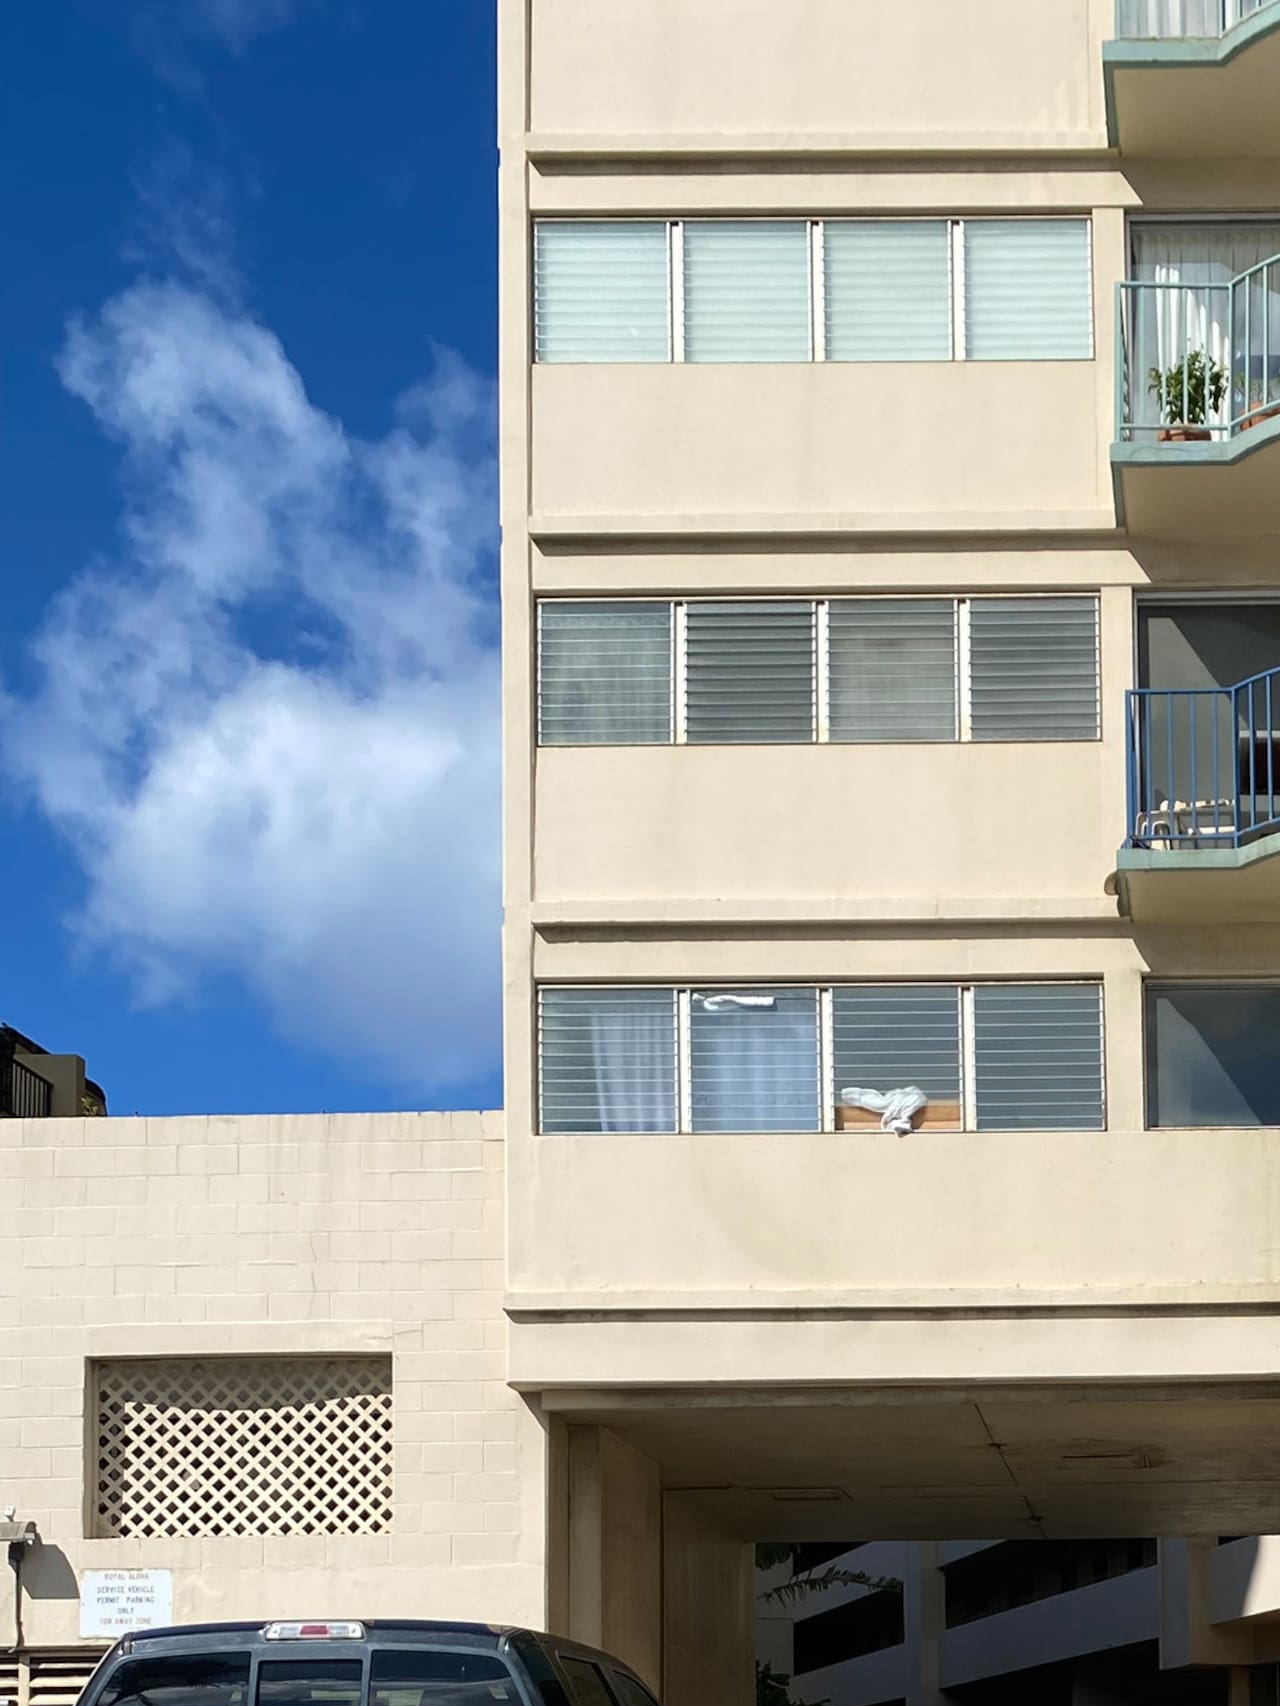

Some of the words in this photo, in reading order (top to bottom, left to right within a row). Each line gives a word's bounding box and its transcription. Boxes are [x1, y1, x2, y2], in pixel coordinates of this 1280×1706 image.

[97, 1586, 125, 1594] SERVICE
[128, 1586, 154, 1594] VEHICLE
[97, 1596, 119, 1604] PERMIT
[126, 1596, 154, 1604] PARKING
[117, 1607, 134, 1615] ONLY
